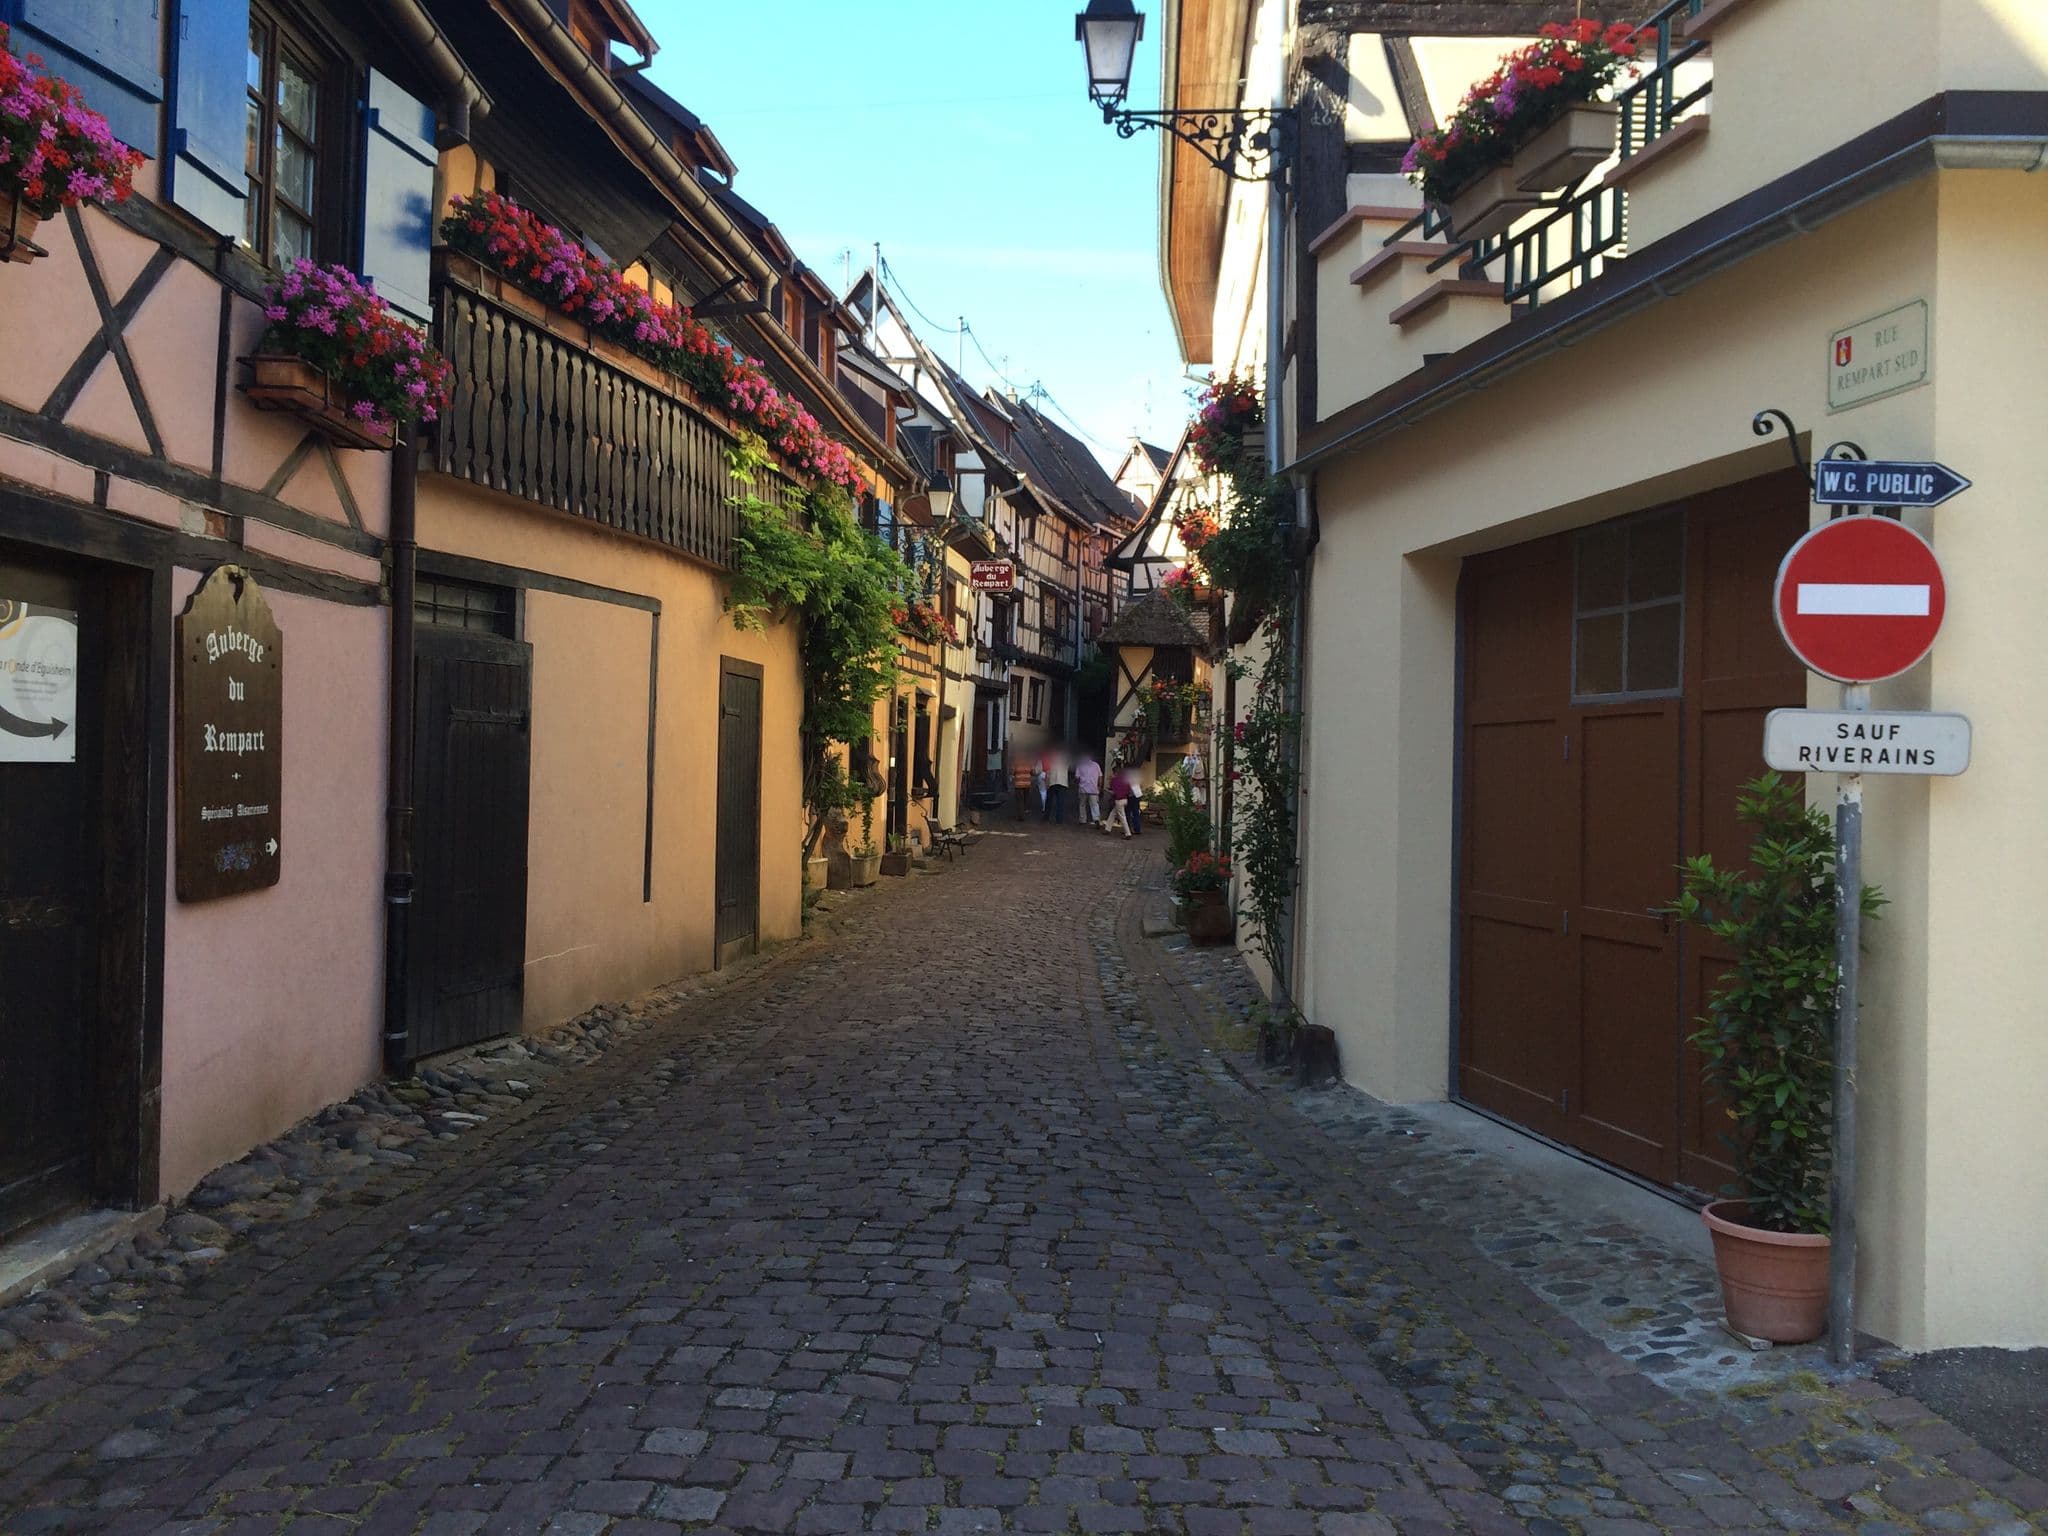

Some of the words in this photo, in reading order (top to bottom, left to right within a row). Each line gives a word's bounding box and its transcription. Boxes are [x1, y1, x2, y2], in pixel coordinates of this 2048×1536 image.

[1875, 326, 1897, 348] RUE
[1837, 358, 1891, 391] REMPART
[1895, 350, 1919, 372] SUD
[1866, 473, 1935, 495] PUBLIC
[973, 563, 1009, 574] Auberge
[972, 579, 1008, 588] Rempart
[206, 624, 264, 664] Auberge
[228, 675, 245, 701] du
[204, 723, 265, 757] Rempart
[1837, 723, 1901, 741] SAUF
[1799, 746, 1936, 766] RIVERAINS
